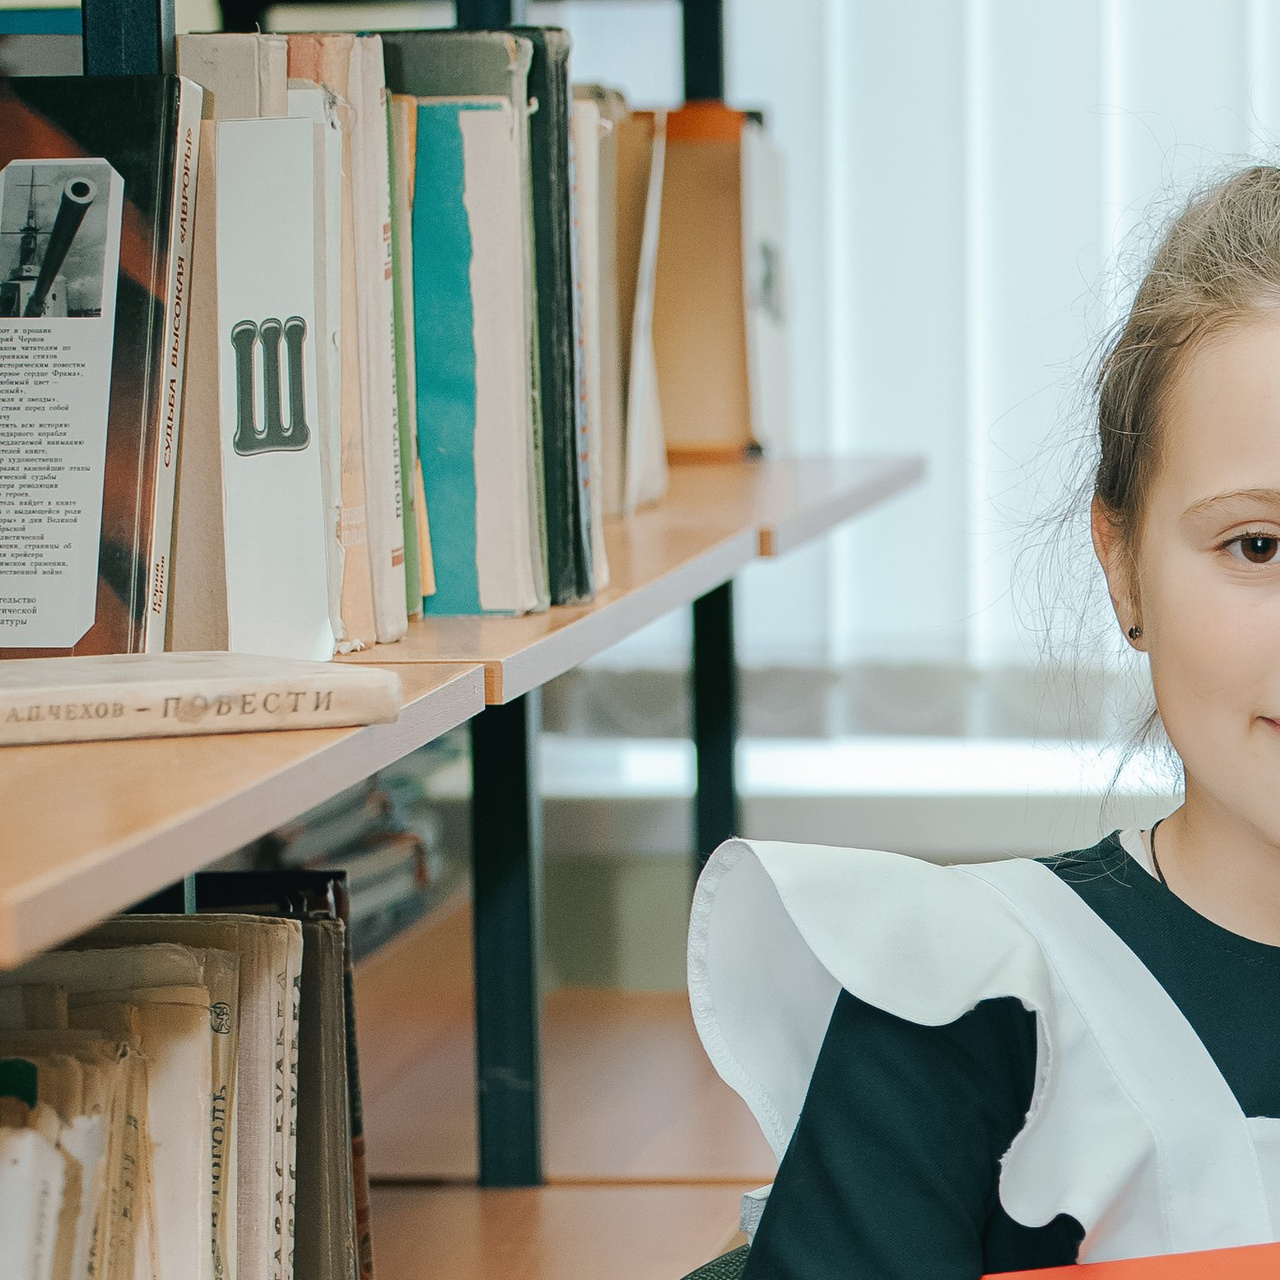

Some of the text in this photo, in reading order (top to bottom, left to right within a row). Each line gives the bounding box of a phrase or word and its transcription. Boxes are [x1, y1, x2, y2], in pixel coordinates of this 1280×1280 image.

[164, 127, 192, 468] СУДЬБА ВЫСОКАЯ «АВРОРЫ»
[19, 336, 44, 344] Чернов
[231, 316, 311, 456] Ш
[38, 430, 66, 438] корабля
[31, 474, 56, 482] судьбы
[19, 499, 43, 507] найдет
[14, 508, 60, 516] выдающейся
[11, 551, 43, 559] крейсера
[152, 563, 160, 613] Юрий
[162, 691, 334, 719] ПОВЕСТИ
